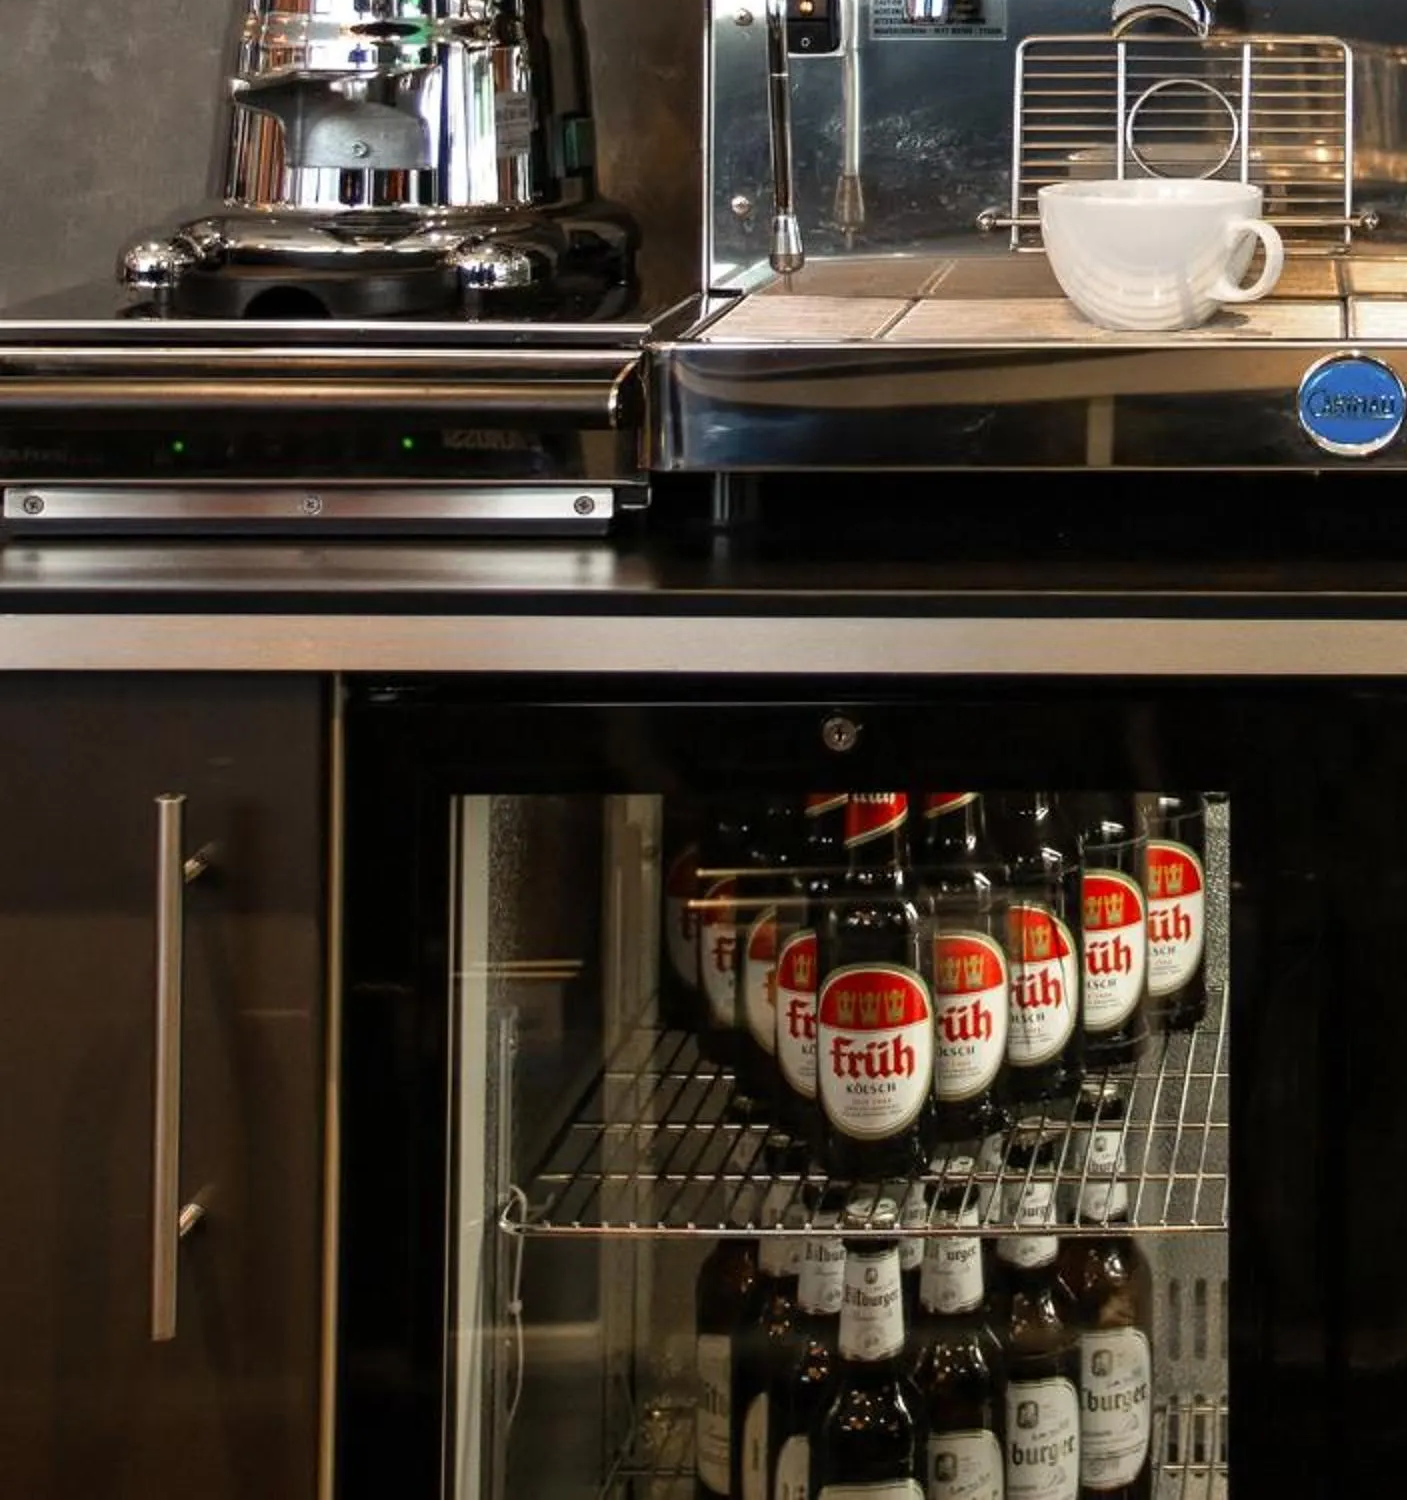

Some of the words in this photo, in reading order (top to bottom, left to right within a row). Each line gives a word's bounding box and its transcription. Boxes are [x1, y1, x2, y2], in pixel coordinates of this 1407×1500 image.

[1148, 903, 1192, 943] üh
[1085, 935, 1132, 975] üh
[786, 998, 816, 1040] fr
[829, 1033, 915, 1078] früh
[846, 1081, 897, 1095] KÖLSCH
[1085, 1383, 1148, 1412] burger
[1011, 1434, 1075, 1466] burger
